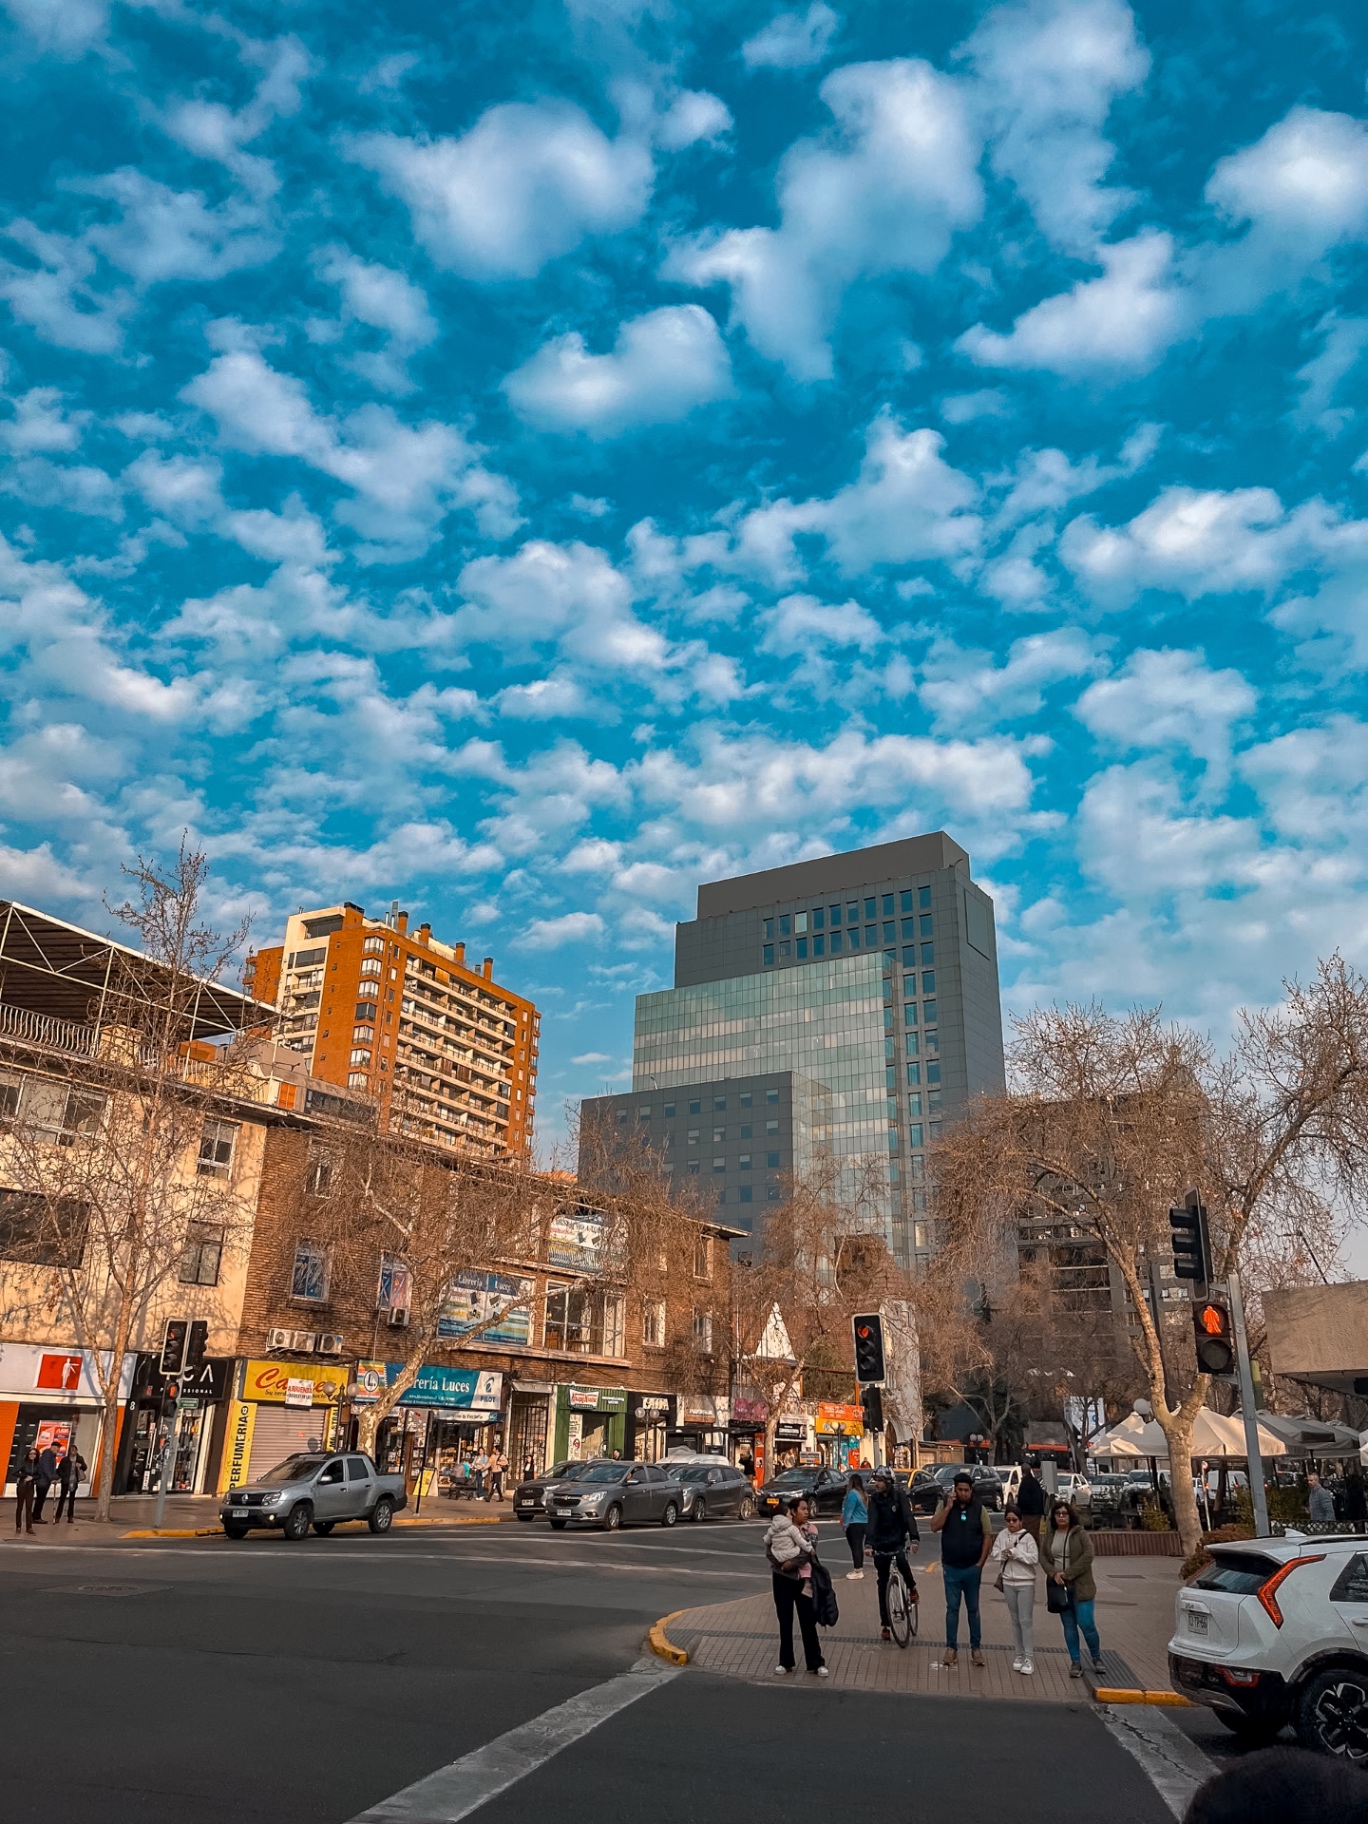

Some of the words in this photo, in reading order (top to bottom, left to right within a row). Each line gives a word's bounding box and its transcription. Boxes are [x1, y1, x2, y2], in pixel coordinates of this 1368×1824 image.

[442, 1377, 470, 1393] Luces
[480, 1395, 496, 1403] PILOT
[229, 1415, 249, 1490] PERFUMERIA
